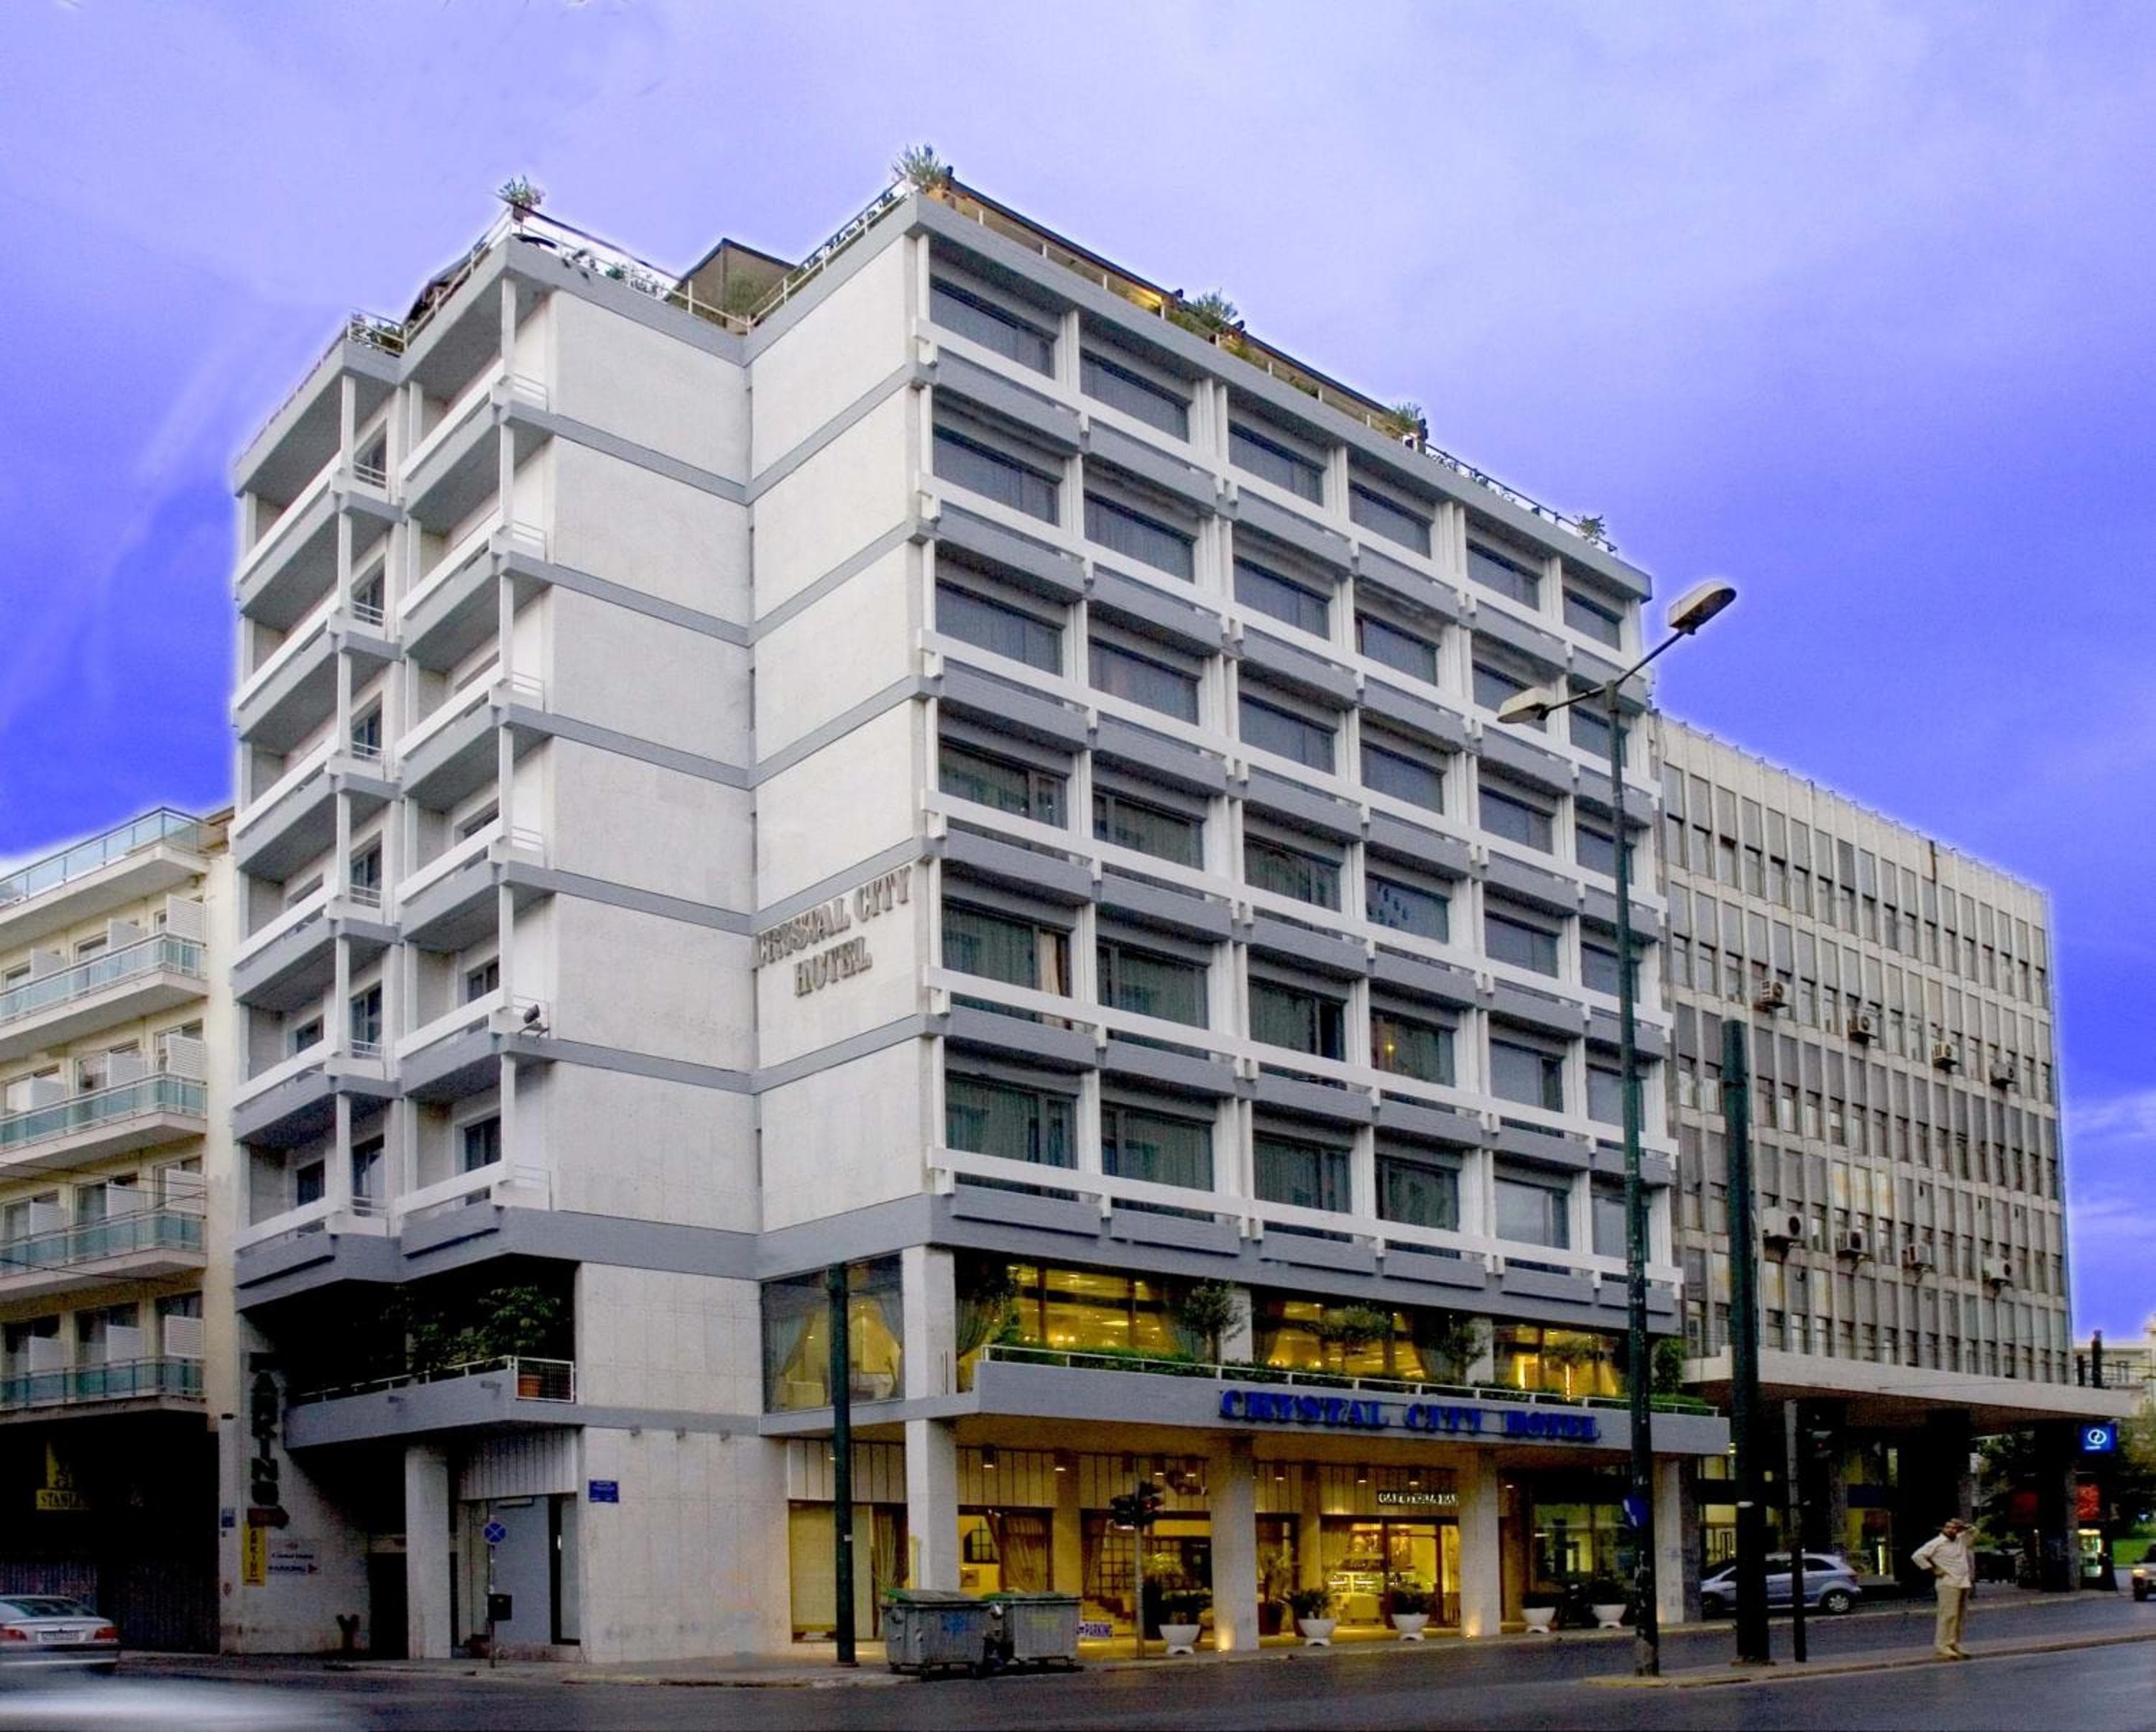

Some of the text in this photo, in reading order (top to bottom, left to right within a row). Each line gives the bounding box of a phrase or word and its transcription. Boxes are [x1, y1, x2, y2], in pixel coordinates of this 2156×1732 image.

[755, 865, 911, 968] CRYSTAL CITY
[793, 936, 872, 998] HOTEL
[1220, 1389, 1602, 1442] CRYSTAL CITY HOTEL
